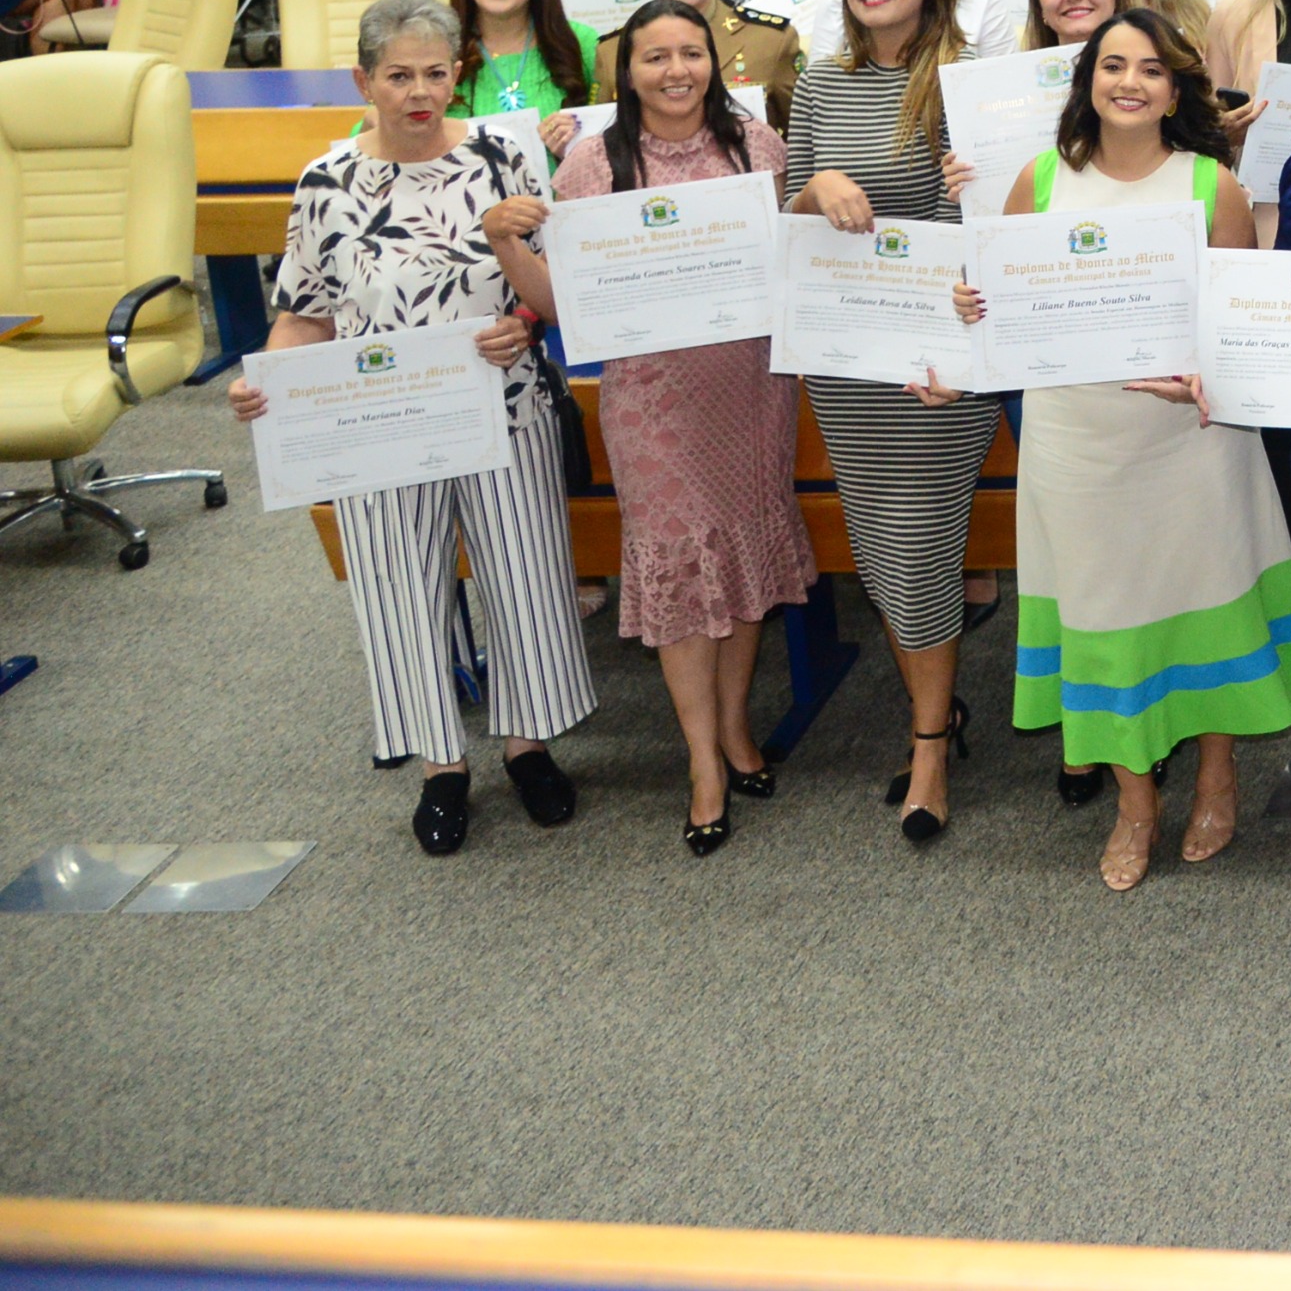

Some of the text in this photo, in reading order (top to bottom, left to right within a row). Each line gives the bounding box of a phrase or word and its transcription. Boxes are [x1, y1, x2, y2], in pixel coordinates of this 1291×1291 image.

[932, 265, 962, 278] Méri
[1004, 253, 1174, 275] Diploma de Honra ao Mérito
[1032, 294, 1150, 311] Liliane Bueno Souto Silva
[1220, 338, 1242, 346] Maria
[1261, 340, 1289, 348] Graças
